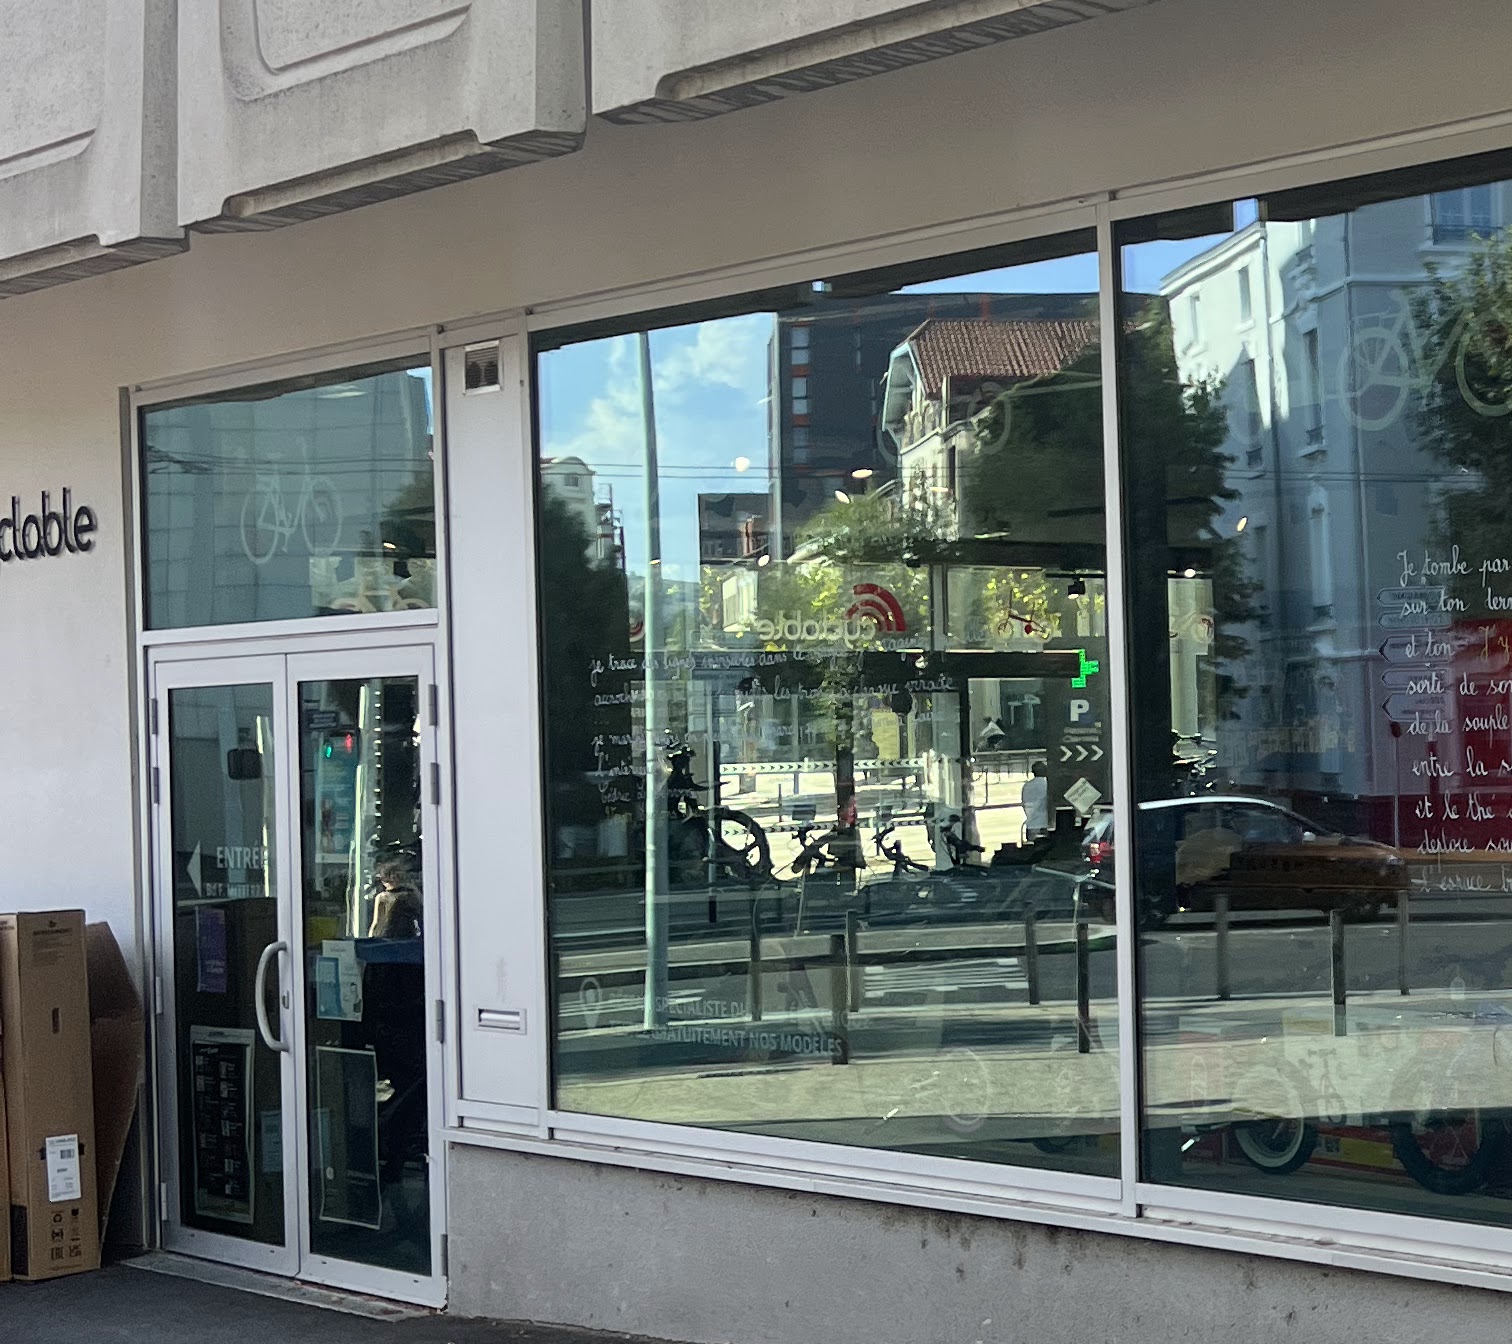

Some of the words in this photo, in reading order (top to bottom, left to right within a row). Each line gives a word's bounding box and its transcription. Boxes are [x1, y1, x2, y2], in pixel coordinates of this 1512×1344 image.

[1397, 550, 1417, 587] Je
[1421, 544, 1473, 575] tombe
[1478, 560, 1512, 588] par
[1400, 599, 1429, 619] sur
[1439, 587, 1471, 612] ton
[1405, 635, 1420, 658] et
[1425, 630, 1457, 657] ton
[1460, 672, 1479, 695] de
[1462, 704, 1509, 749] souple
[1412, 752, 1454, 777] entre
[1467, 746, 1488, 776] la
[1415, 795, 1433, 819] et
[1443, 793, 1460, 820] le
[1466, 792, 1496, 821] thé
[750, 1032, 777, 1050] NOS
[780, 1033, 842, 1057] MODÈLES
